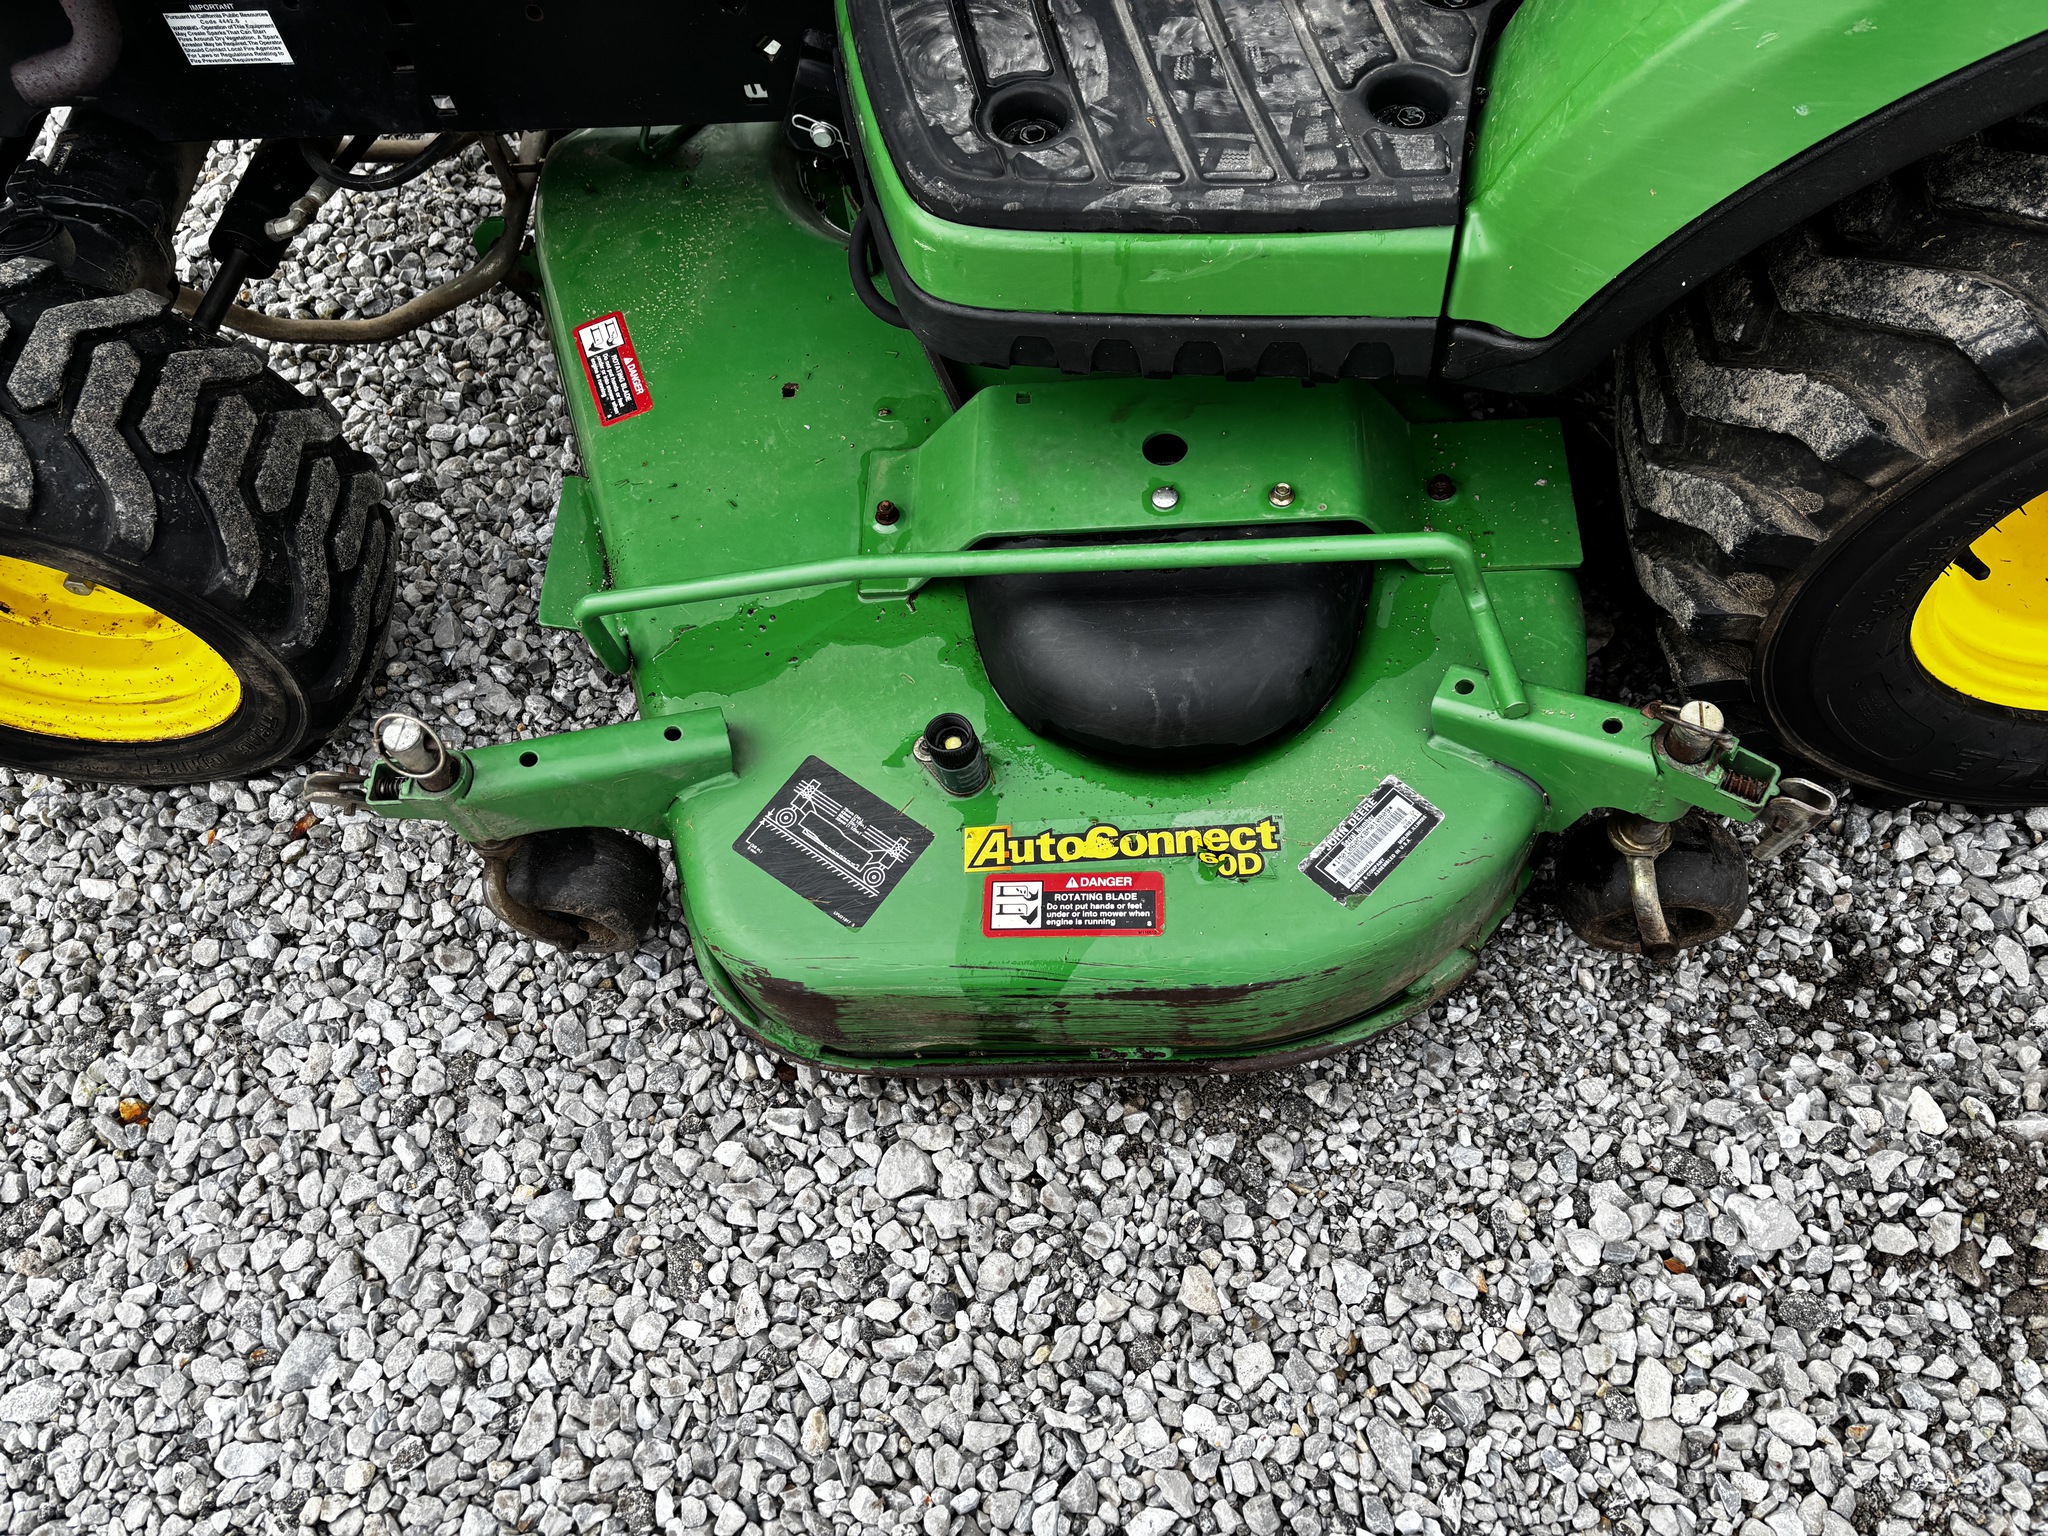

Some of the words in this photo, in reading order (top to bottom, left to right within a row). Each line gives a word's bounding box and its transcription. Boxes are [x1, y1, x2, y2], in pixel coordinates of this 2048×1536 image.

[189, 3, 234, 11] IMPORTANT
[590, 358, 599, 374] engine
[596, 379, 607, 398] running
[611, 354, 625, 382] ROTATING
[620, 383, 632, 402] BLADE
[611, 377, 620, 392] hands
[627, 363, 645, 395] DANGER
[606, 385, 615, 401] mower
[1323, 826, 1349, 851] JOHN
[1348, 798, 1378, 826] DEERE
[1341, 832, 1357, 847] Serial
[1355, 814, 1375, 833] Number
[967, 819, 1279, 867] AutoConnect
[1351, 880, 1364, 892] DEERE
[1366, 858, 1385, 876] COMPANY
[1374, 854, 1396, 876] ASSEMBLED
[1080, 877, 1132, 886] DANGER
[1054, 893, 1103, 901] ROTATING
[1105, 893, 1137, 901] BLADE
[1075, 903, 1089, 911] put
[1046, 918, 1073, 927] engine
[1084, 918, 1116, 927] running
